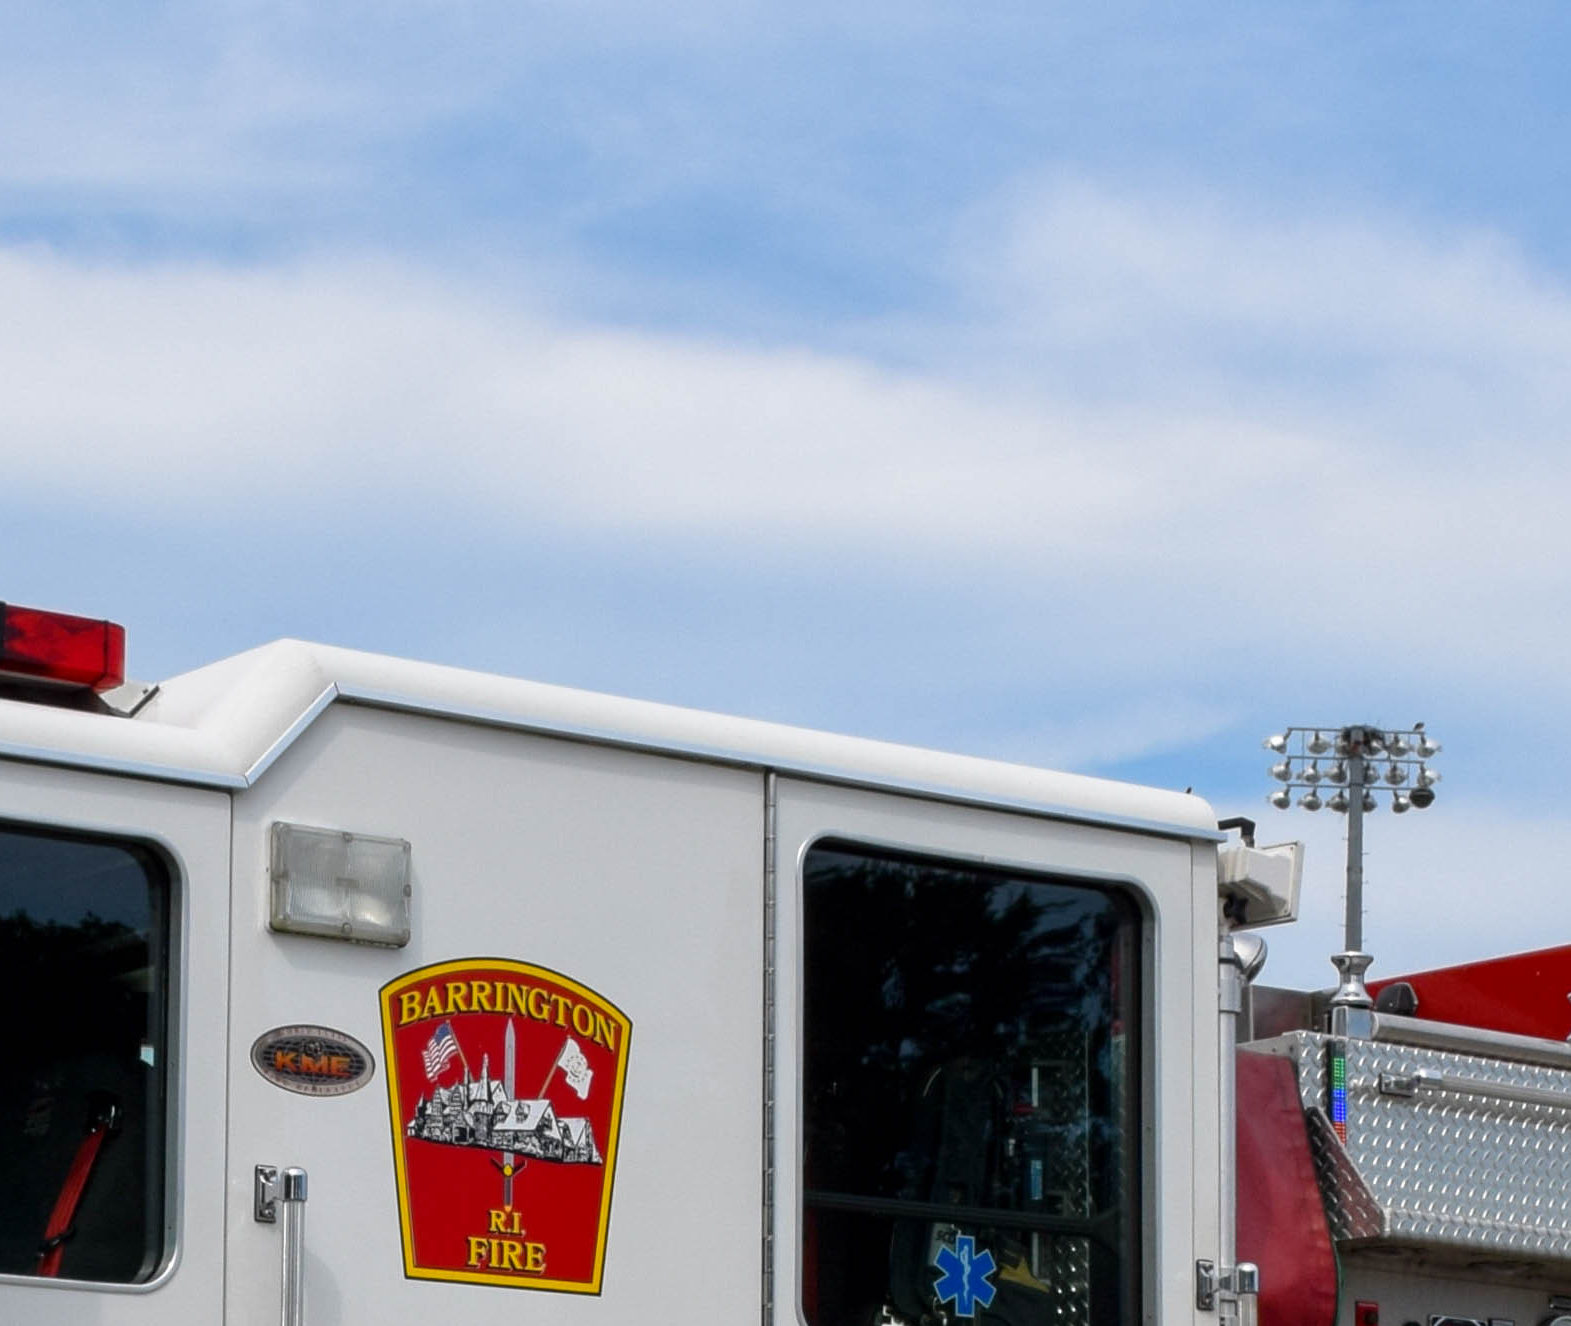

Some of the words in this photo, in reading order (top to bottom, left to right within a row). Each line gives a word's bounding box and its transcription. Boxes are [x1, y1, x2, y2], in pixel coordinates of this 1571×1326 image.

[398, 979, 617, 1052] BARRINGTON
[274, 1050, 352, 1078] KME
[488, 1209, 526, 1236] R.I.
[467, 1236, 548, 1274] FIRE
